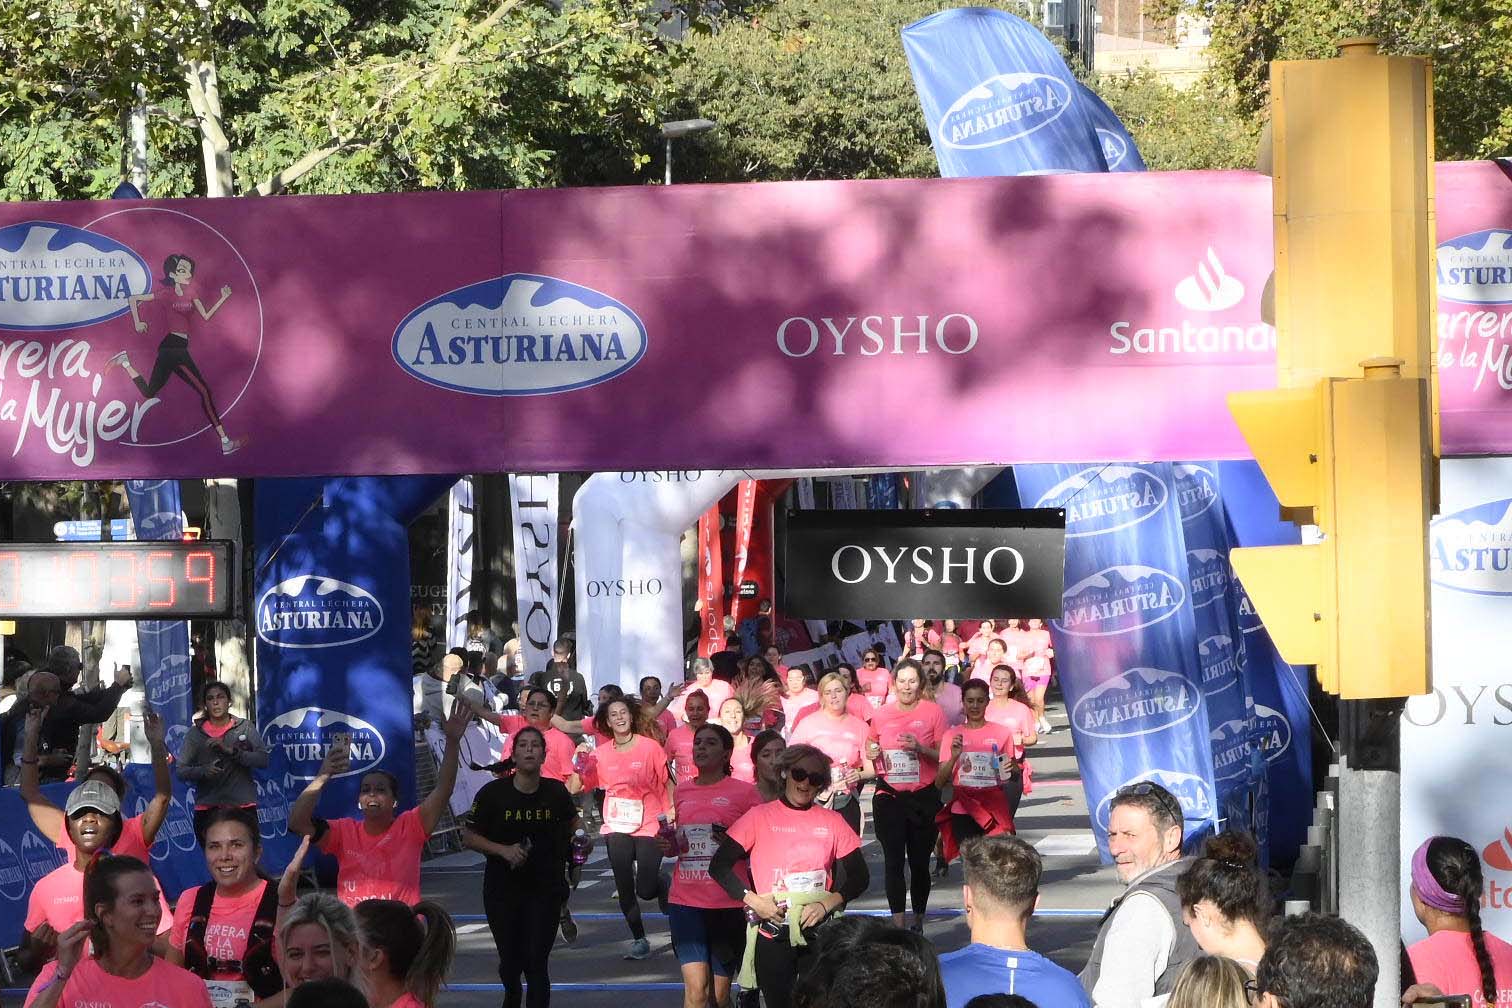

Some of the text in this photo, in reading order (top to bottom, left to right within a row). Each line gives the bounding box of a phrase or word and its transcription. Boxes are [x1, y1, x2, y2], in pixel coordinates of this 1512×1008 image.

[54, 258, 127, 271] LECHERA
[451, 315, 619, 329] CENTRAL LECHERA
[412, 320, 627, 367] ASTURIANA
[776, 313, 979, 357] OYSHO
[1109, 319, 1277, 354] Santand
[12, 375, 162, 467] Mujer
[830, 544, 1026, 586] OYSHO
[586, 578, 663, 599] OYSHO
[274, 600, 370, 609] CENTRAL LECHERA
[262, 602, 375, 633] ASTURIANA
[705, 580, 718, 655] Sports
[275, 732, 318, 741] CENTRAL
[973, 765, 986, 773] 016
[504, 808, 553, 822] PACER
[690, 842, 707, 850] 016
[217, 937, 232, 950] LA
